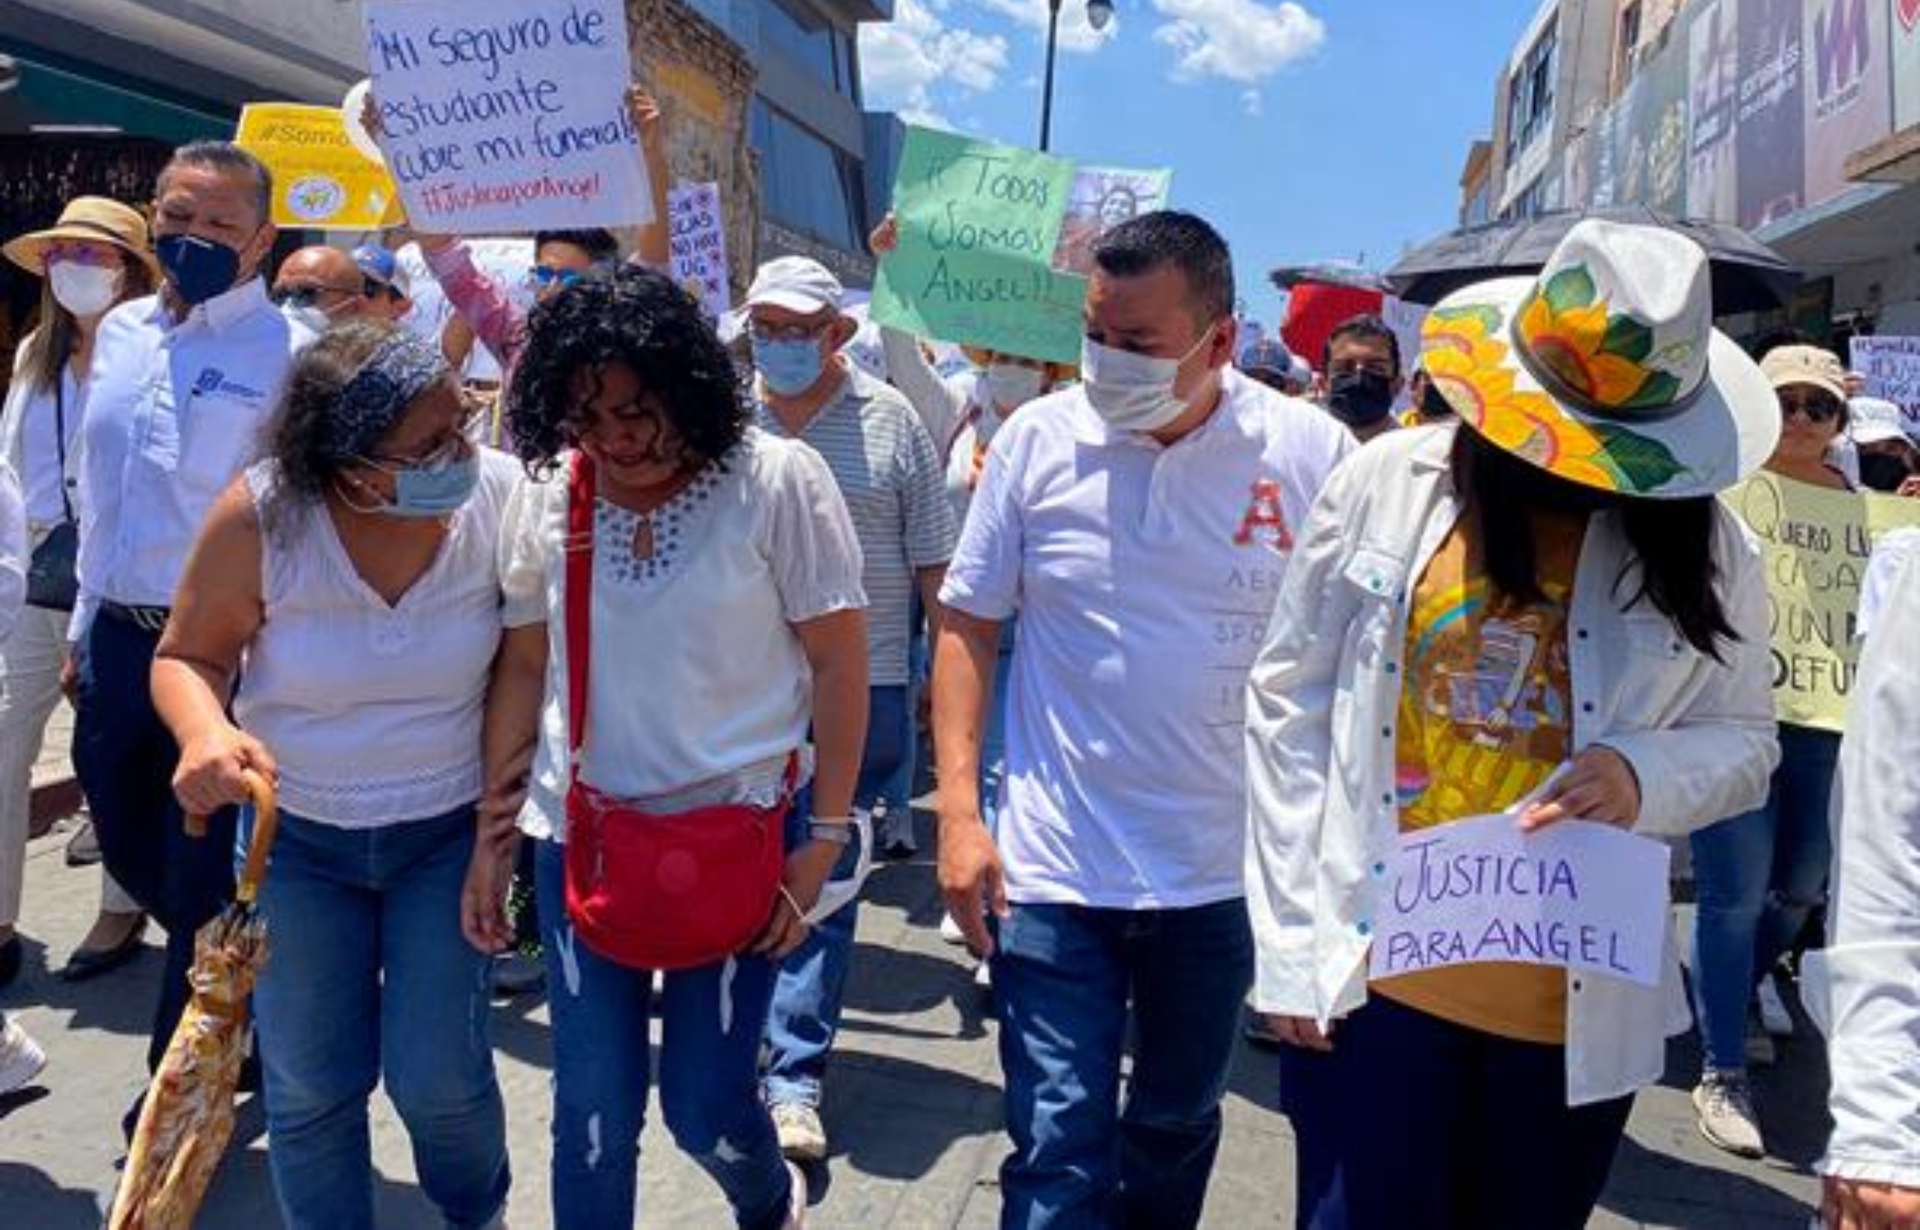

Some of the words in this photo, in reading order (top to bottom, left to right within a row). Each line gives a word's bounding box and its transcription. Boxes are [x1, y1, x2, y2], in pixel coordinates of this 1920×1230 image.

[563, 4, 604, 47] de
[1385, 930, 1468, 971] PARA
[1471, 918, 1633, 975] ANGEL
